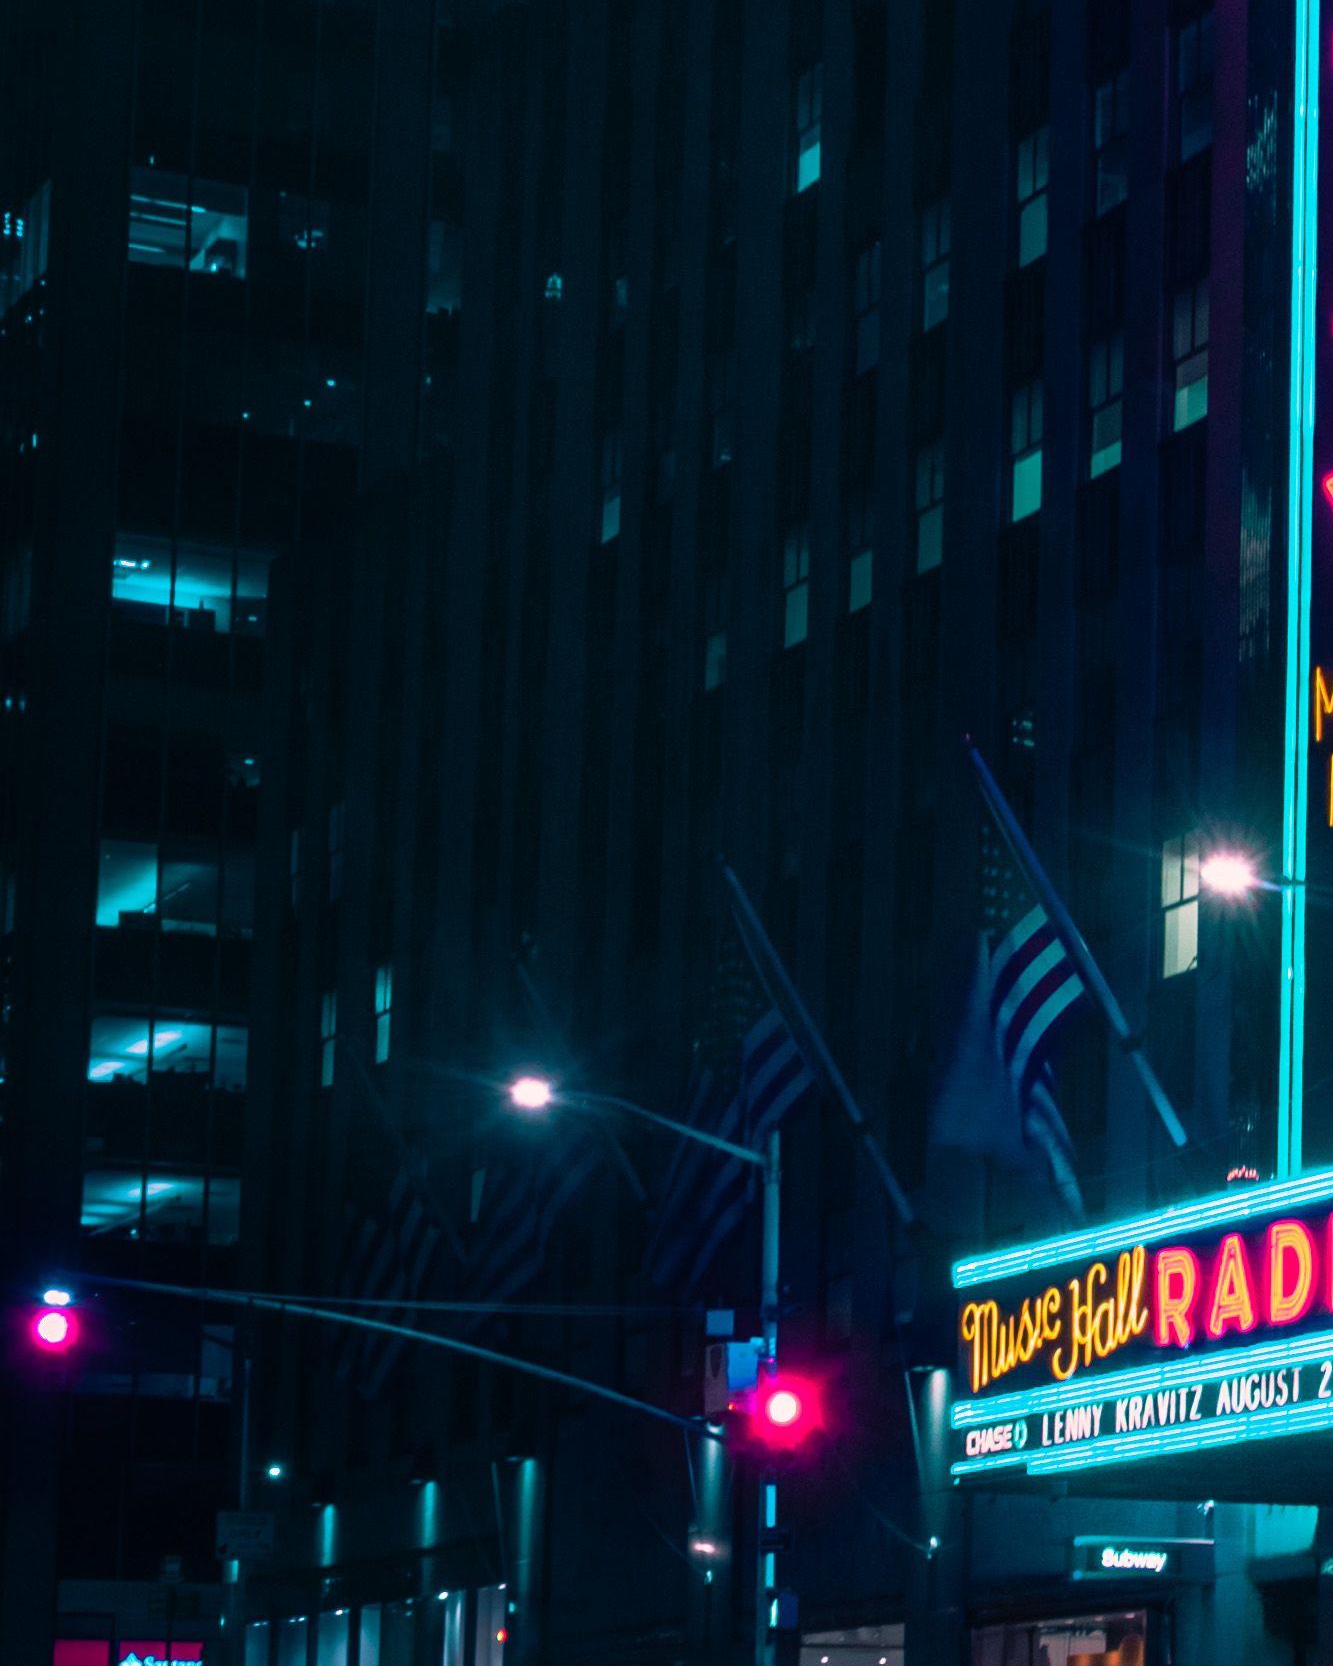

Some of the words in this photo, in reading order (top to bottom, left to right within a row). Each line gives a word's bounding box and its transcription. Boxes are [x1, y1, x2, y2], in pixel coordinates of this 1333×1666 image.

[961, 1287, 1061, 1392] Music
[1052, 1246, 1149, 1380] Hall
[1041, 1404, 1103, 1447] LENNY
[1115, 1383, 1203, 1433] KRAVITZ
[1216, 1366, 1302, 1416] AUGUST
[966, 1423, 1013, 1457] CHASE
[1101, 1546, 1168, 1573] Subway
